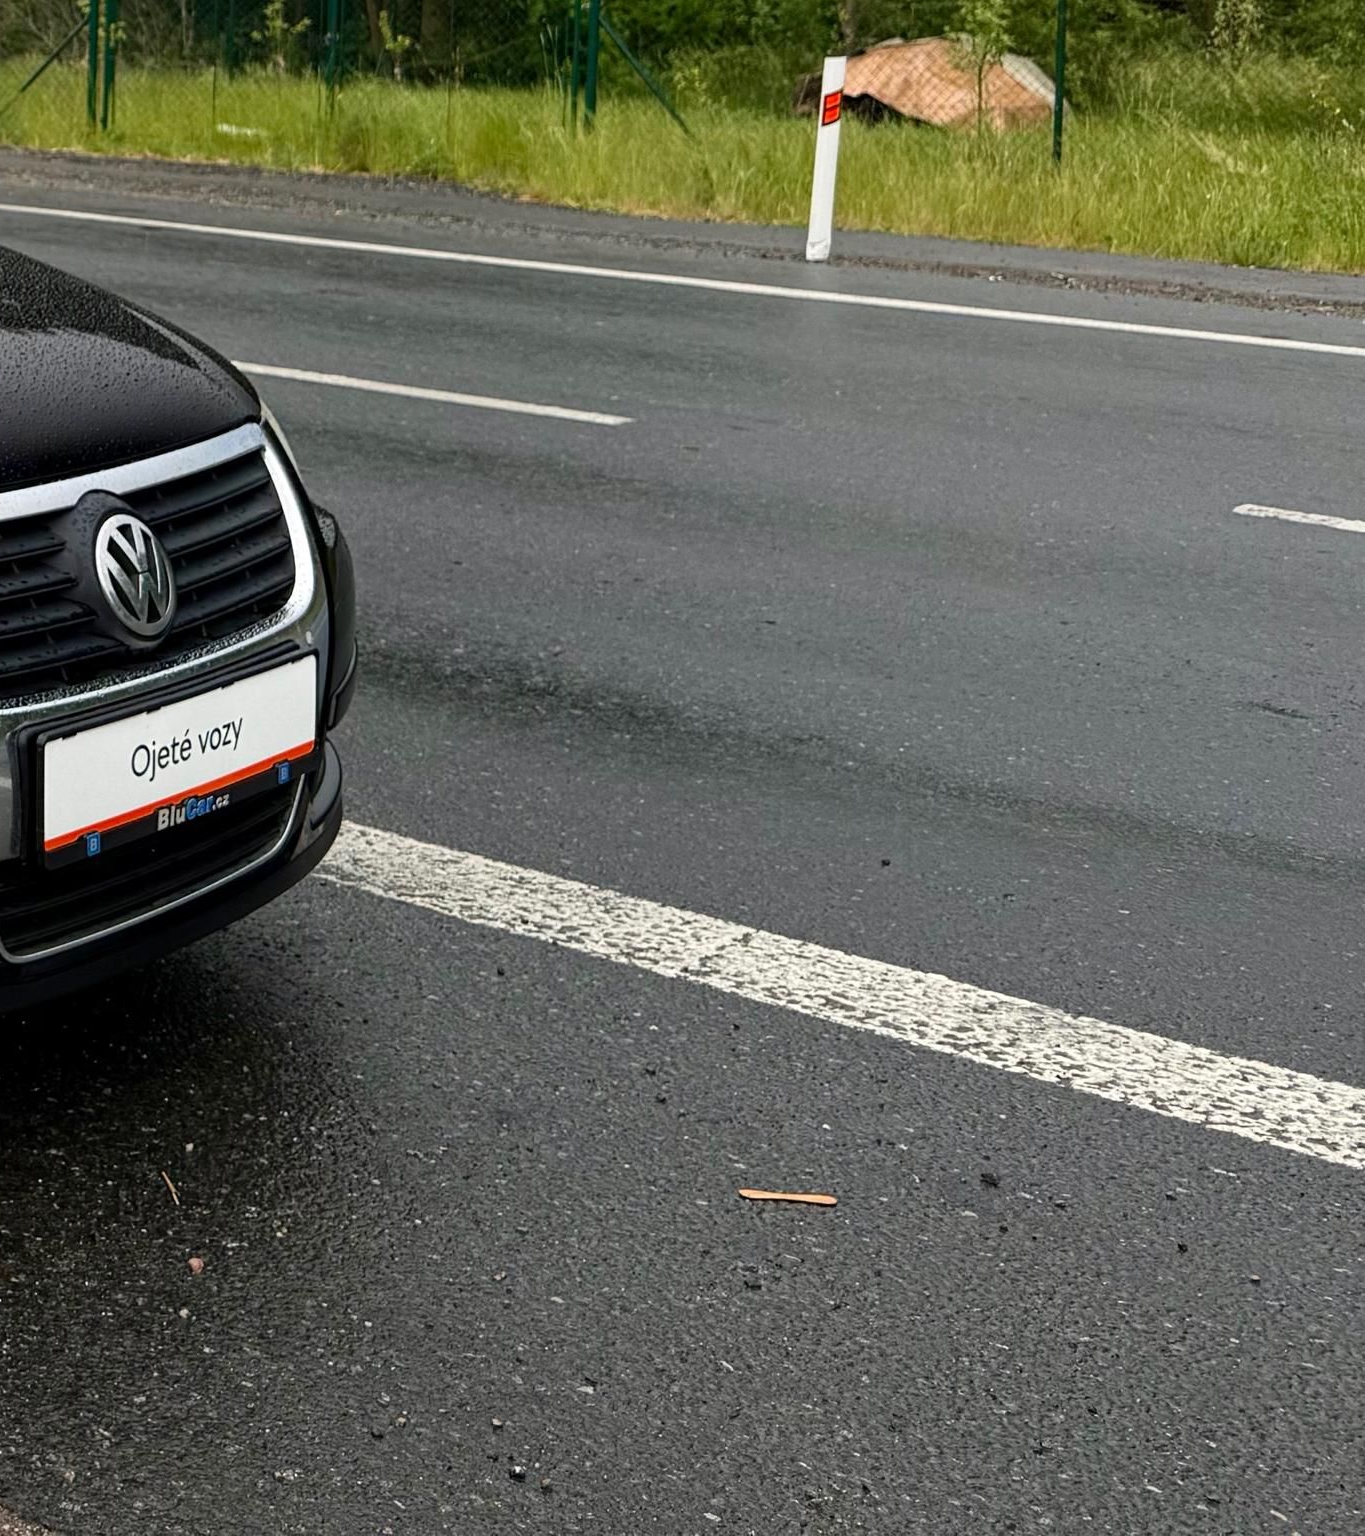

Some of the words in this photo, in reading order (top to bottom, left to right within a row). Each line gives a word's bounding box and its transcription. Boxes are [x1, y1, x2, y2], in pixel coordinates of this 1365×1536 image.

[96, 514, 176, 636] VW
[131, 728, 193, 782] Ojeté
[198, 717, 243, 751] vozy
[157, 793, 230, 831] BluCar.cz
